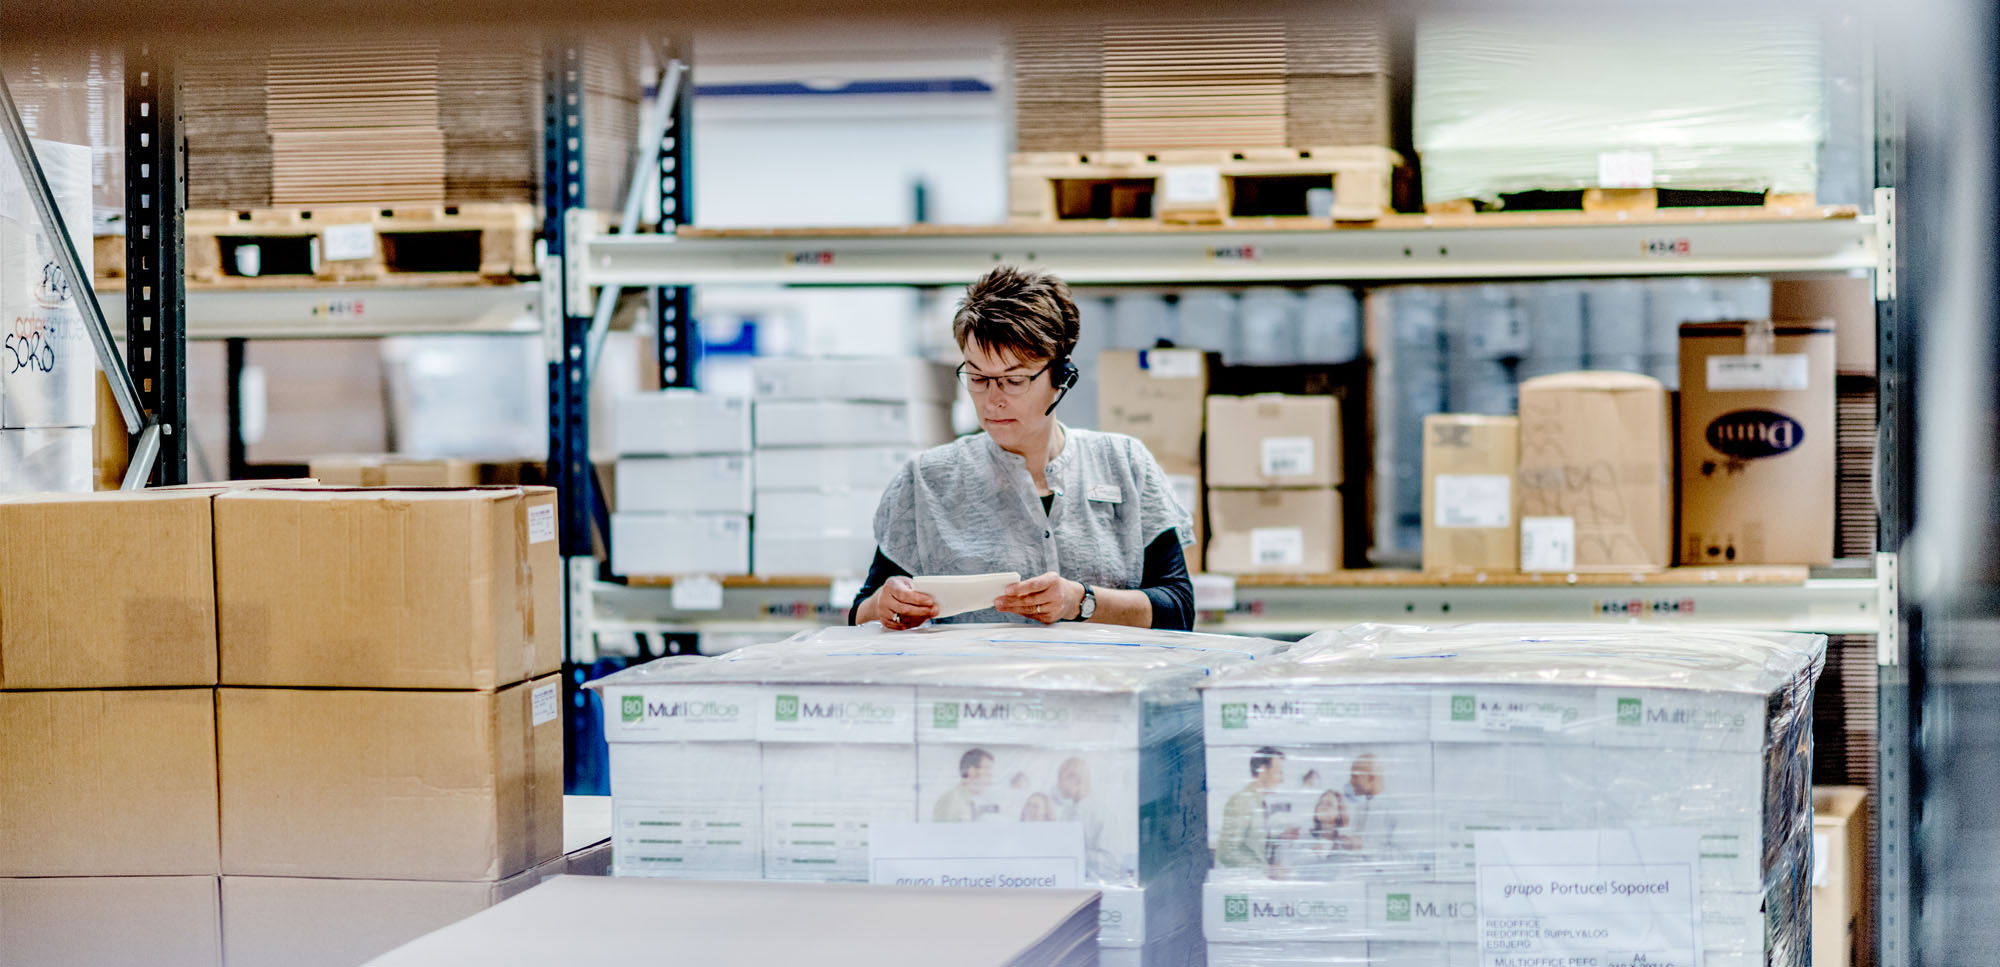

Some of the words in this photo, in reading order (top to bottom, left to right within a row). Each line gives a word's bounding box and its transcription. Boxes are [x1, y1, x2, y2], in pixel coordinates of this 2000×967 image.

[623, 701, 642, 714] 80
[777, 699, 796, 714] 80
[1454, 699, 1473, 714] 80
[941, 874, 996, 888] Portucel
[999, 873, 1057, 888] Soporcel
[1503, 881, 1543, 898] grupo
[1550, 880, 1608, 895] Portucel
[1611, 880, 1669, 896] Soporcel
[1227, 900, 1246, 914] 80
[1633, 953, 1647, 962] A4
